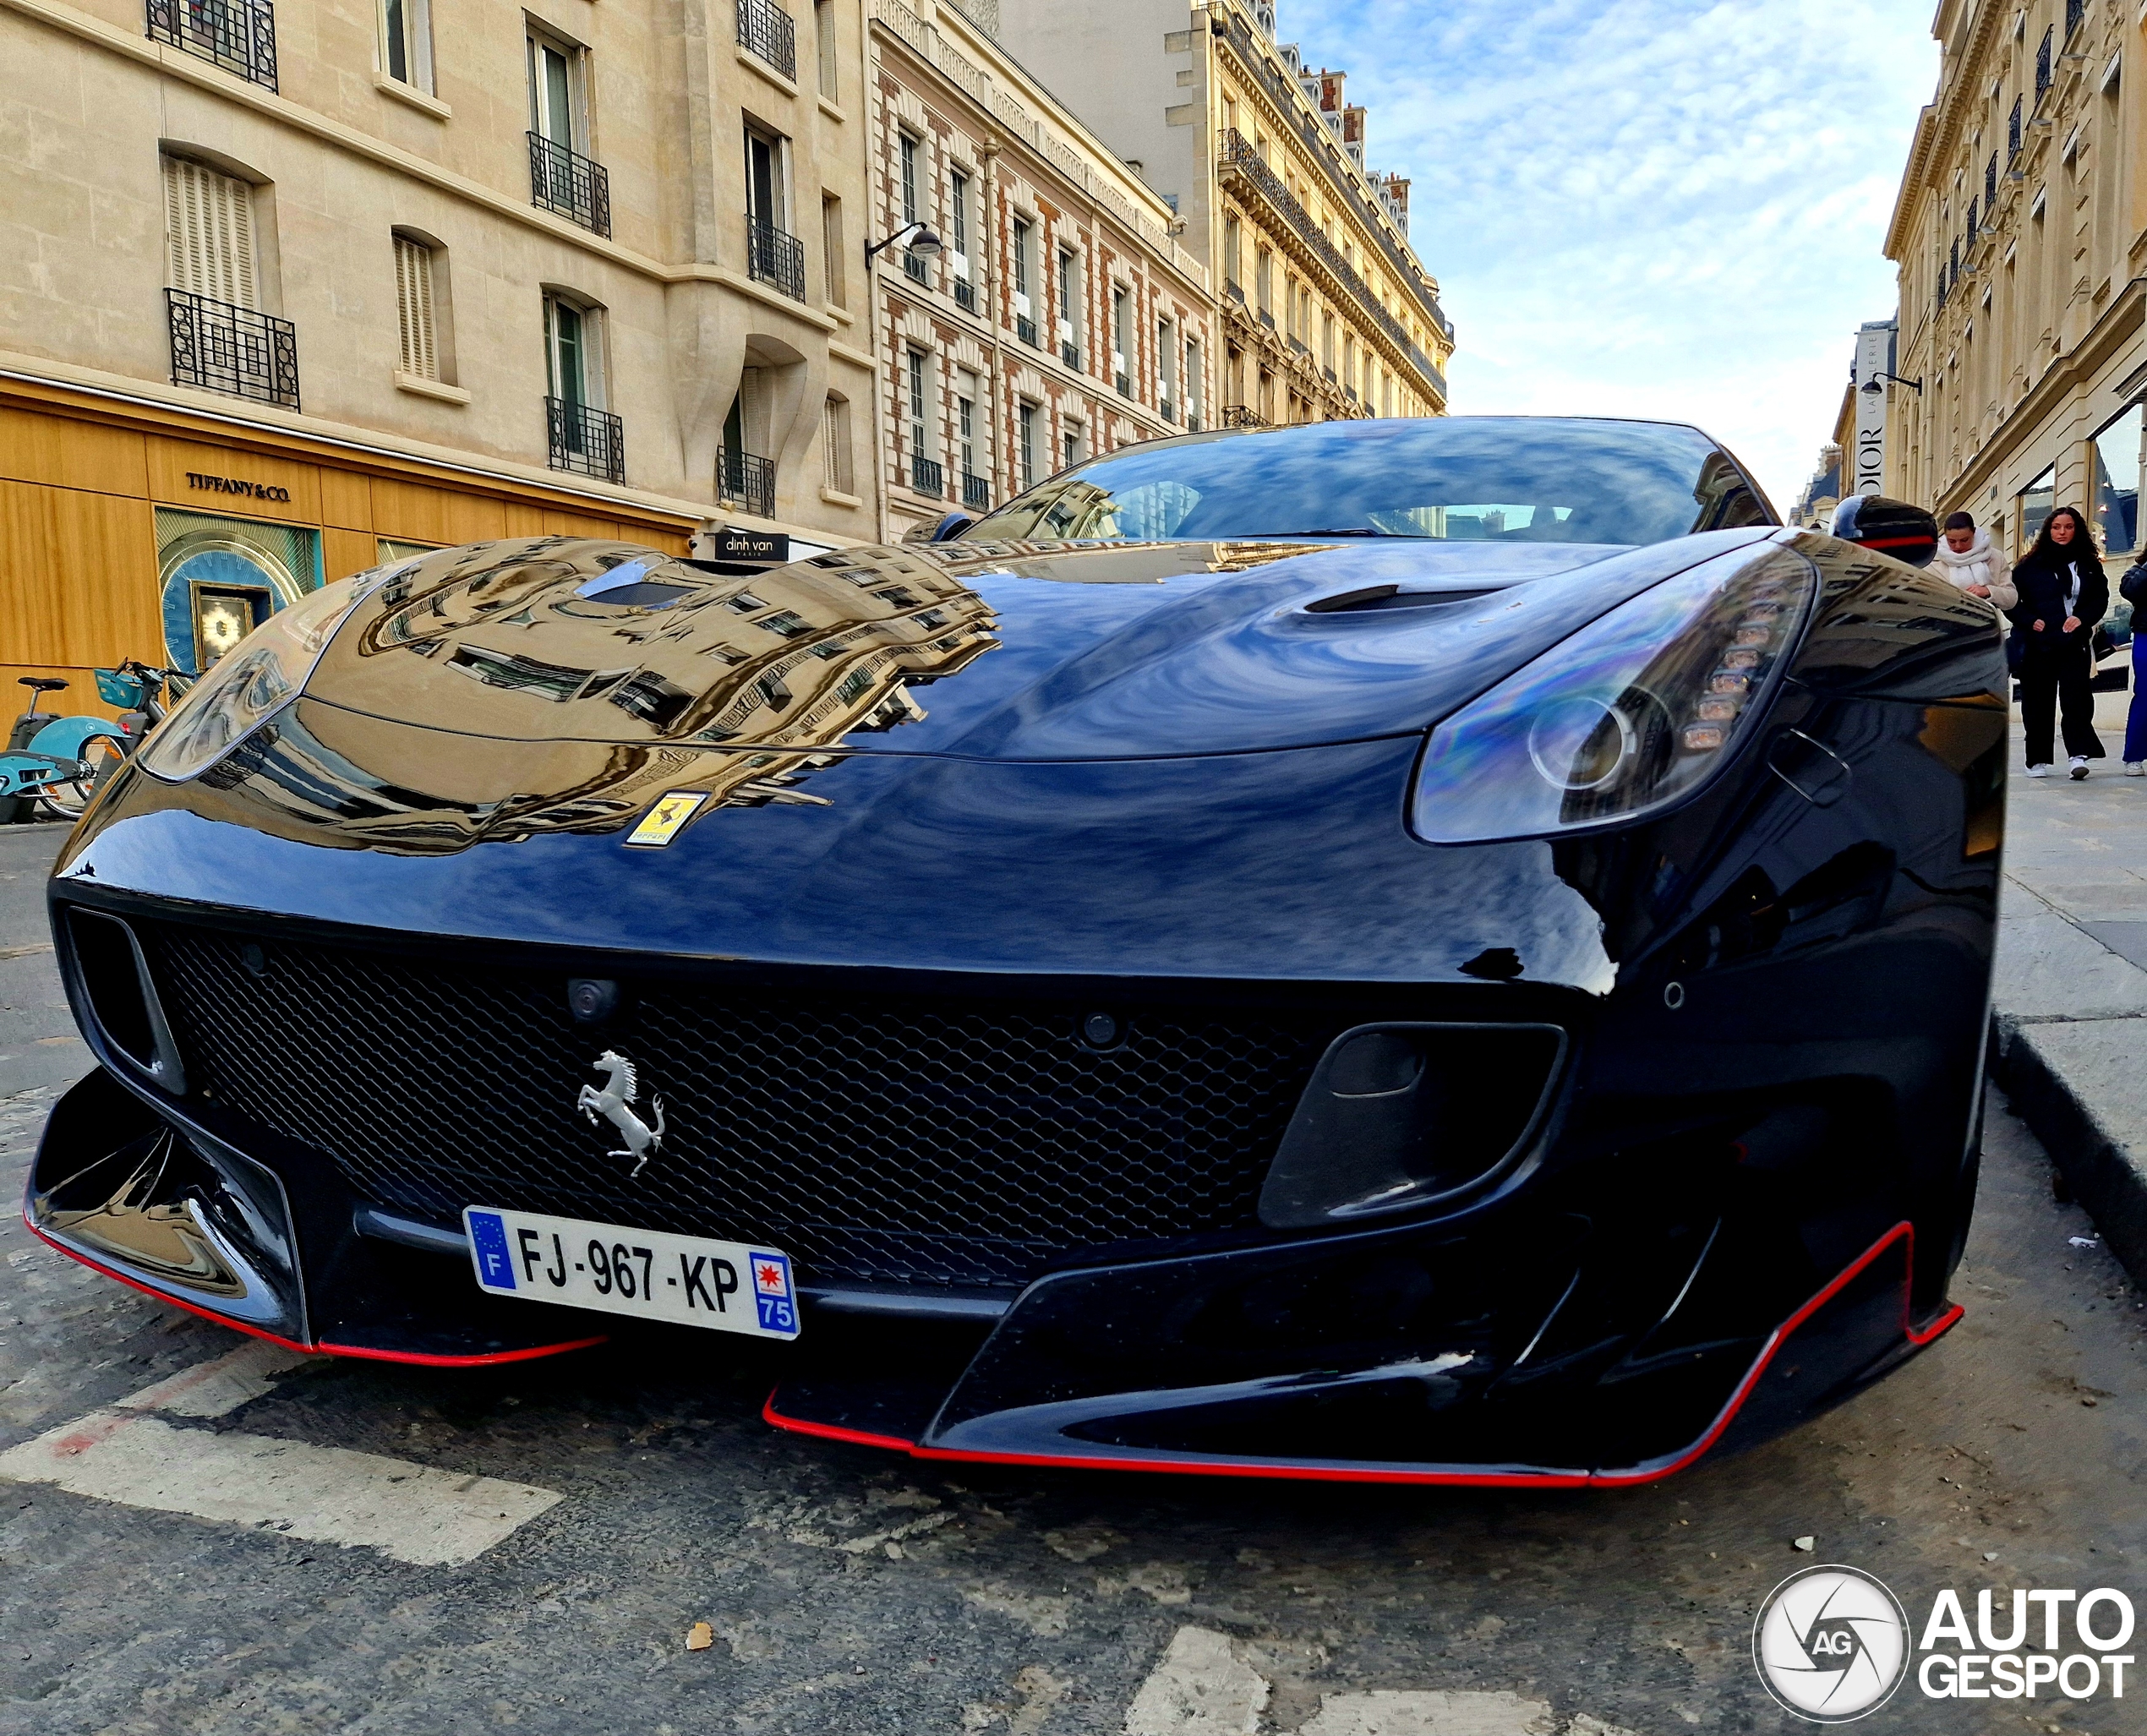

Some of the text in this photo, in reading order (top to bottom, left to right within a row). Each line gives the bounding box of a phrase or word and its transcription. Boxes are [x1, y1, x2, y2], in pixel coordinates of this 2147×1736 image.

[1859, 425, 1883, 497] DIOR
[726, 536, 773, 551] dinh van
[487, 1253, 501, 1276] F
[516, 1228, 739, 1313] FJ-967-KP
[759, 1297, 792, 1327] 75
